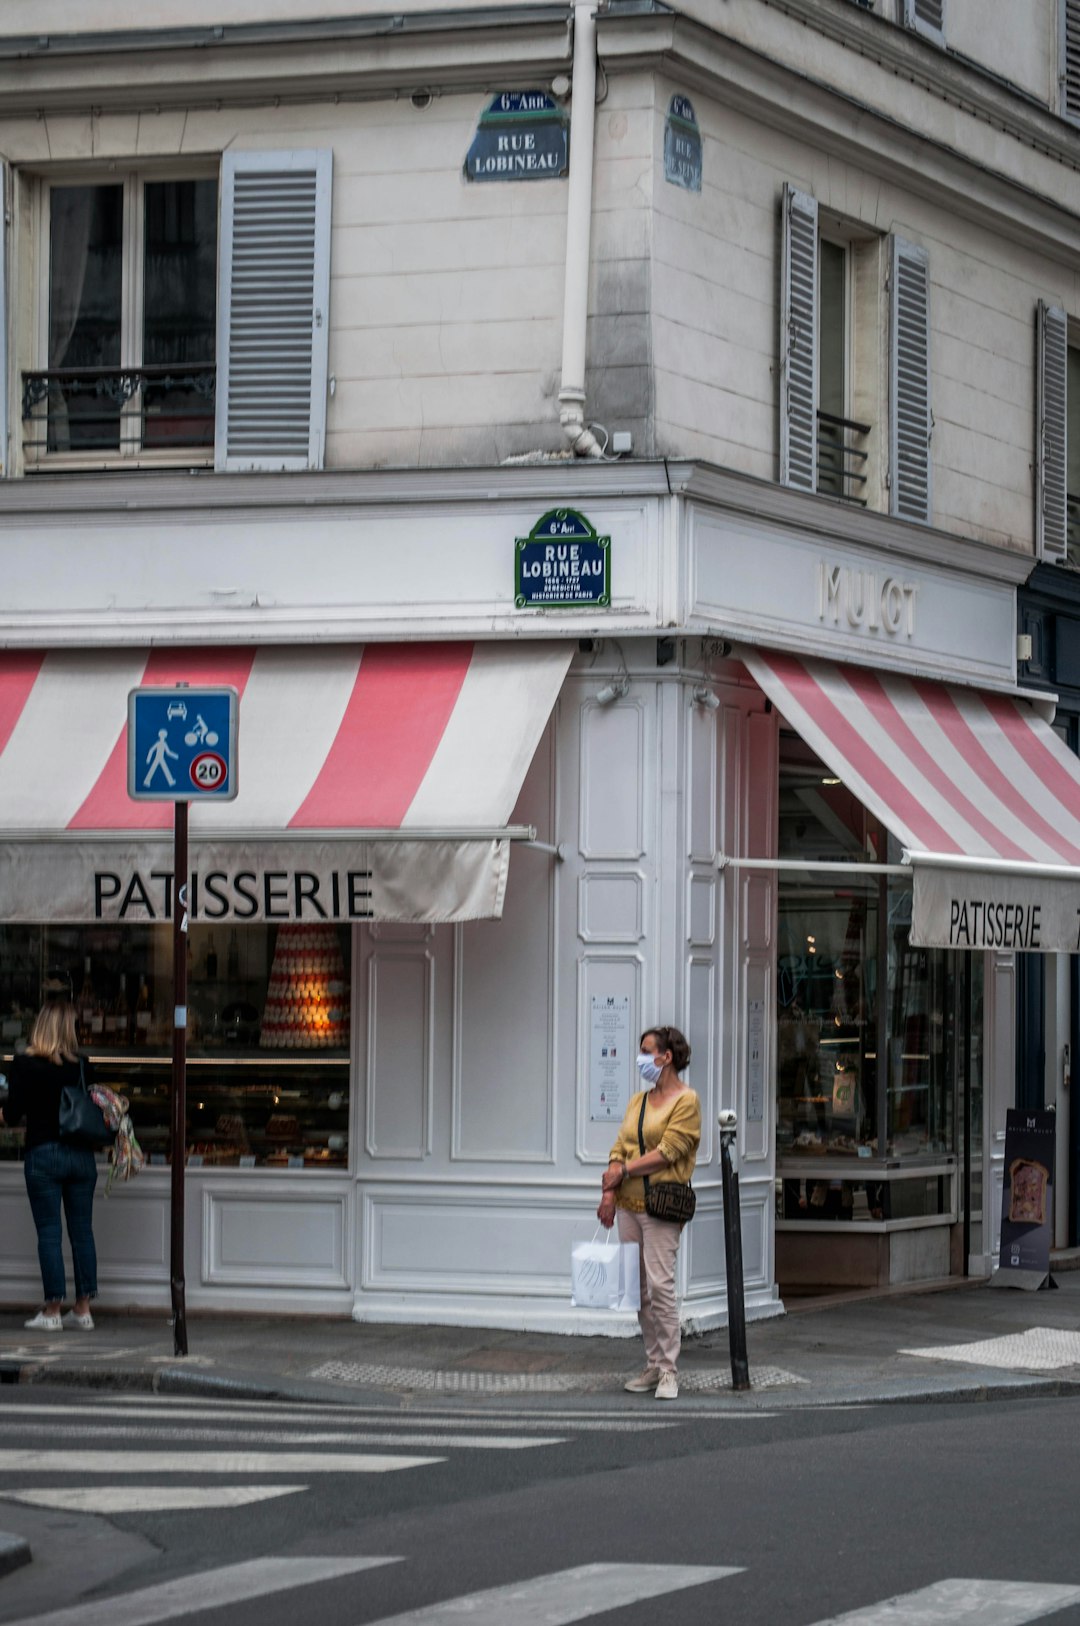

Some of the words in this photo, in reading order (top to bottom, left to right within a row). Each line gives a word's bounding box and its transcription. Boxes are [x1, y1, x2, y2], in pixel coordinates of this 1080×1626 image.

[498, 133, 535, 151] RUE
[676, 137, 691, 159] RUE
[475, 152, 558, 173] LOBINEAU
[545, 544, 579, 561] RUE
[523, 559, 602, 578] LOBINEAU
[565, 591, 573, 599] DE
[575, 590, 593, 599] PARIS
[199, 763, 218, 780] 20
[94, 871, 373, 919] PATISSERIE
[950, 899, 1041, 948] PATISSERIE
